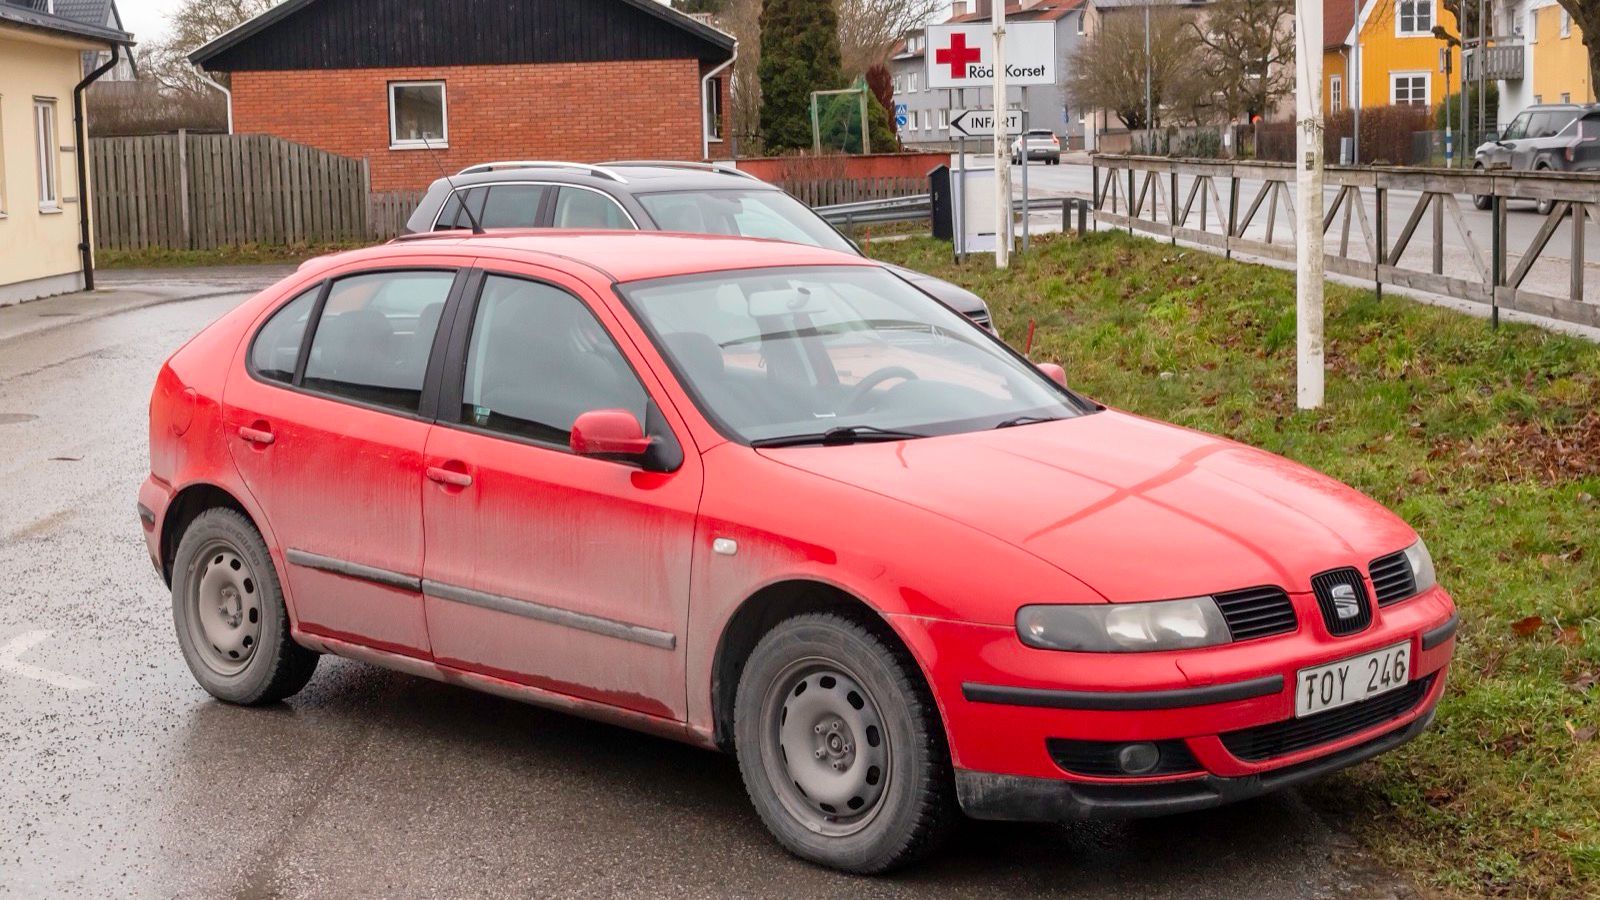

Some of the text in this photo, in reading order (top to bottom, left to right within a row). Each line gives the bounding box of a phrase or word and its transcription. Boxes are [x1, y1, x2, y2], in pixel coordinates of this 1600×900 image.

[969, 64, 1045, 78] Röd Korset
[971, 116, 1017, 128] INFT
[1305, 650, 1406, 709] TOY 246
